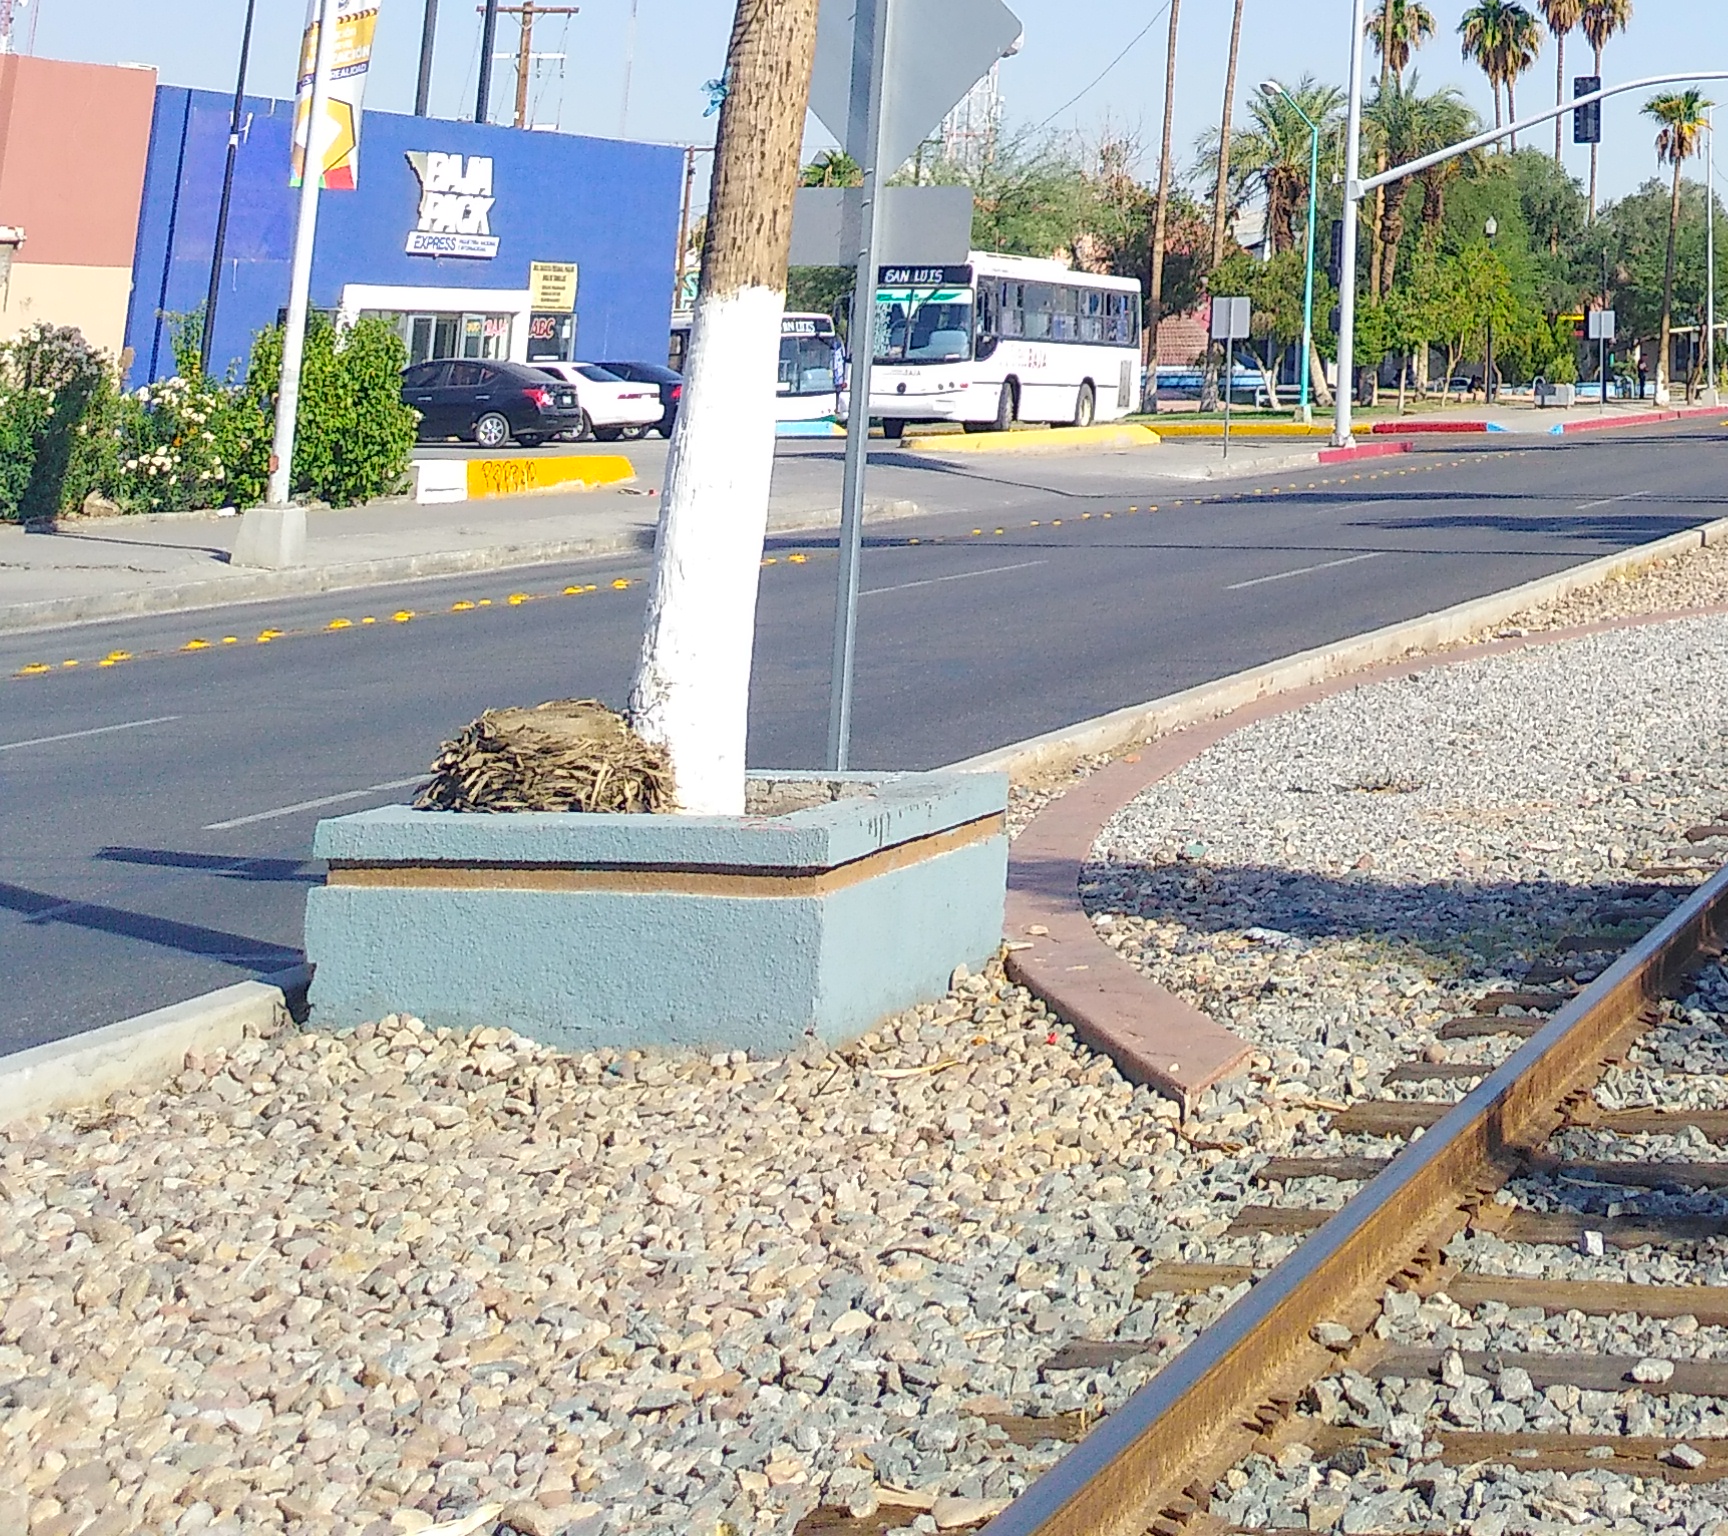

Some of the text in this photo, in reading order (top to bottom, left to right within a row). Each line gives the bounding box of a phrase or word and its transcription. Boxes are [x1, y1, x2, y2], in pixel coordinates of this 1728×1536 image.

[414, 234, 457, 251] EXPRESS
[884, 268, 944, 283] SAN LUIS
[529, 317, 557, 341] ABC
[780, 320, 795, 333] AN
